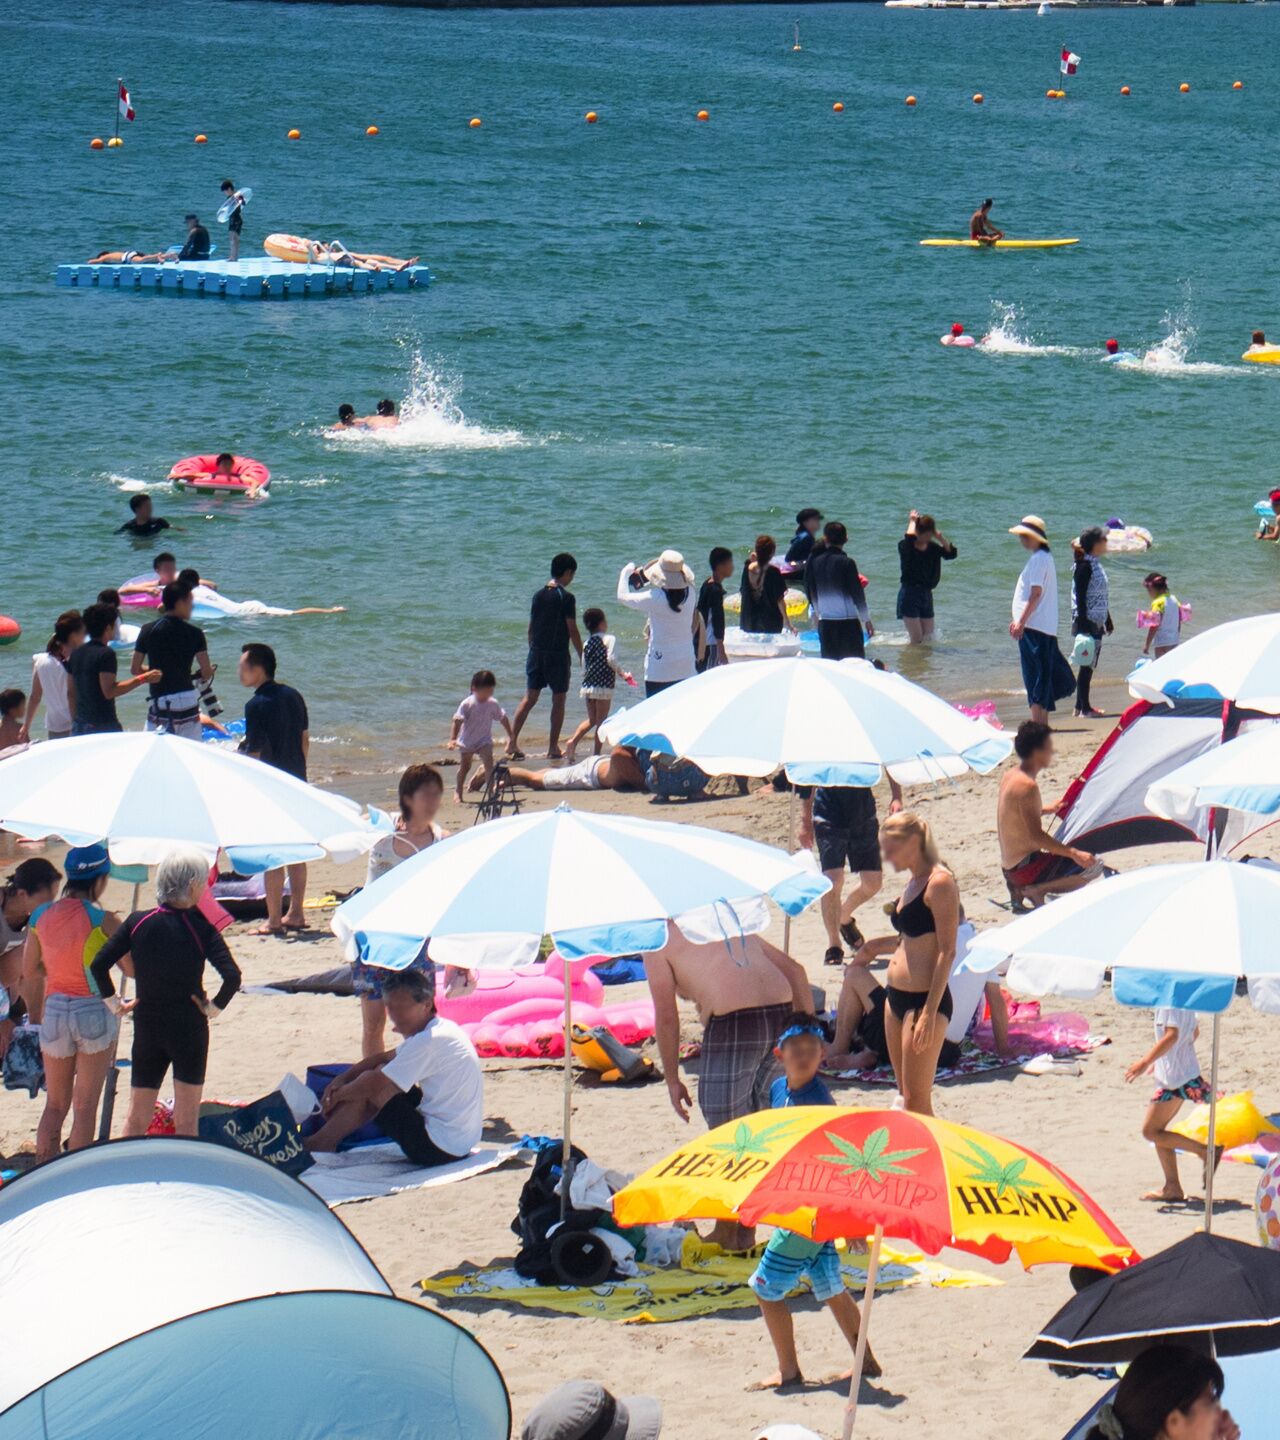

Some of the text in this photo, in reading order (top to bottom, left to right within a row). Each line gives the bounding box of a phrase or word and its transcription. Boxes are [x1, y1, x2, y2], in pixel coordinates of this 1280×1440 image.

[656, 1152, 769, 1182] HEMP
[774, 1160, 937, 1210] HEMP
[956, 1185, 1077, 1222] HEMP
